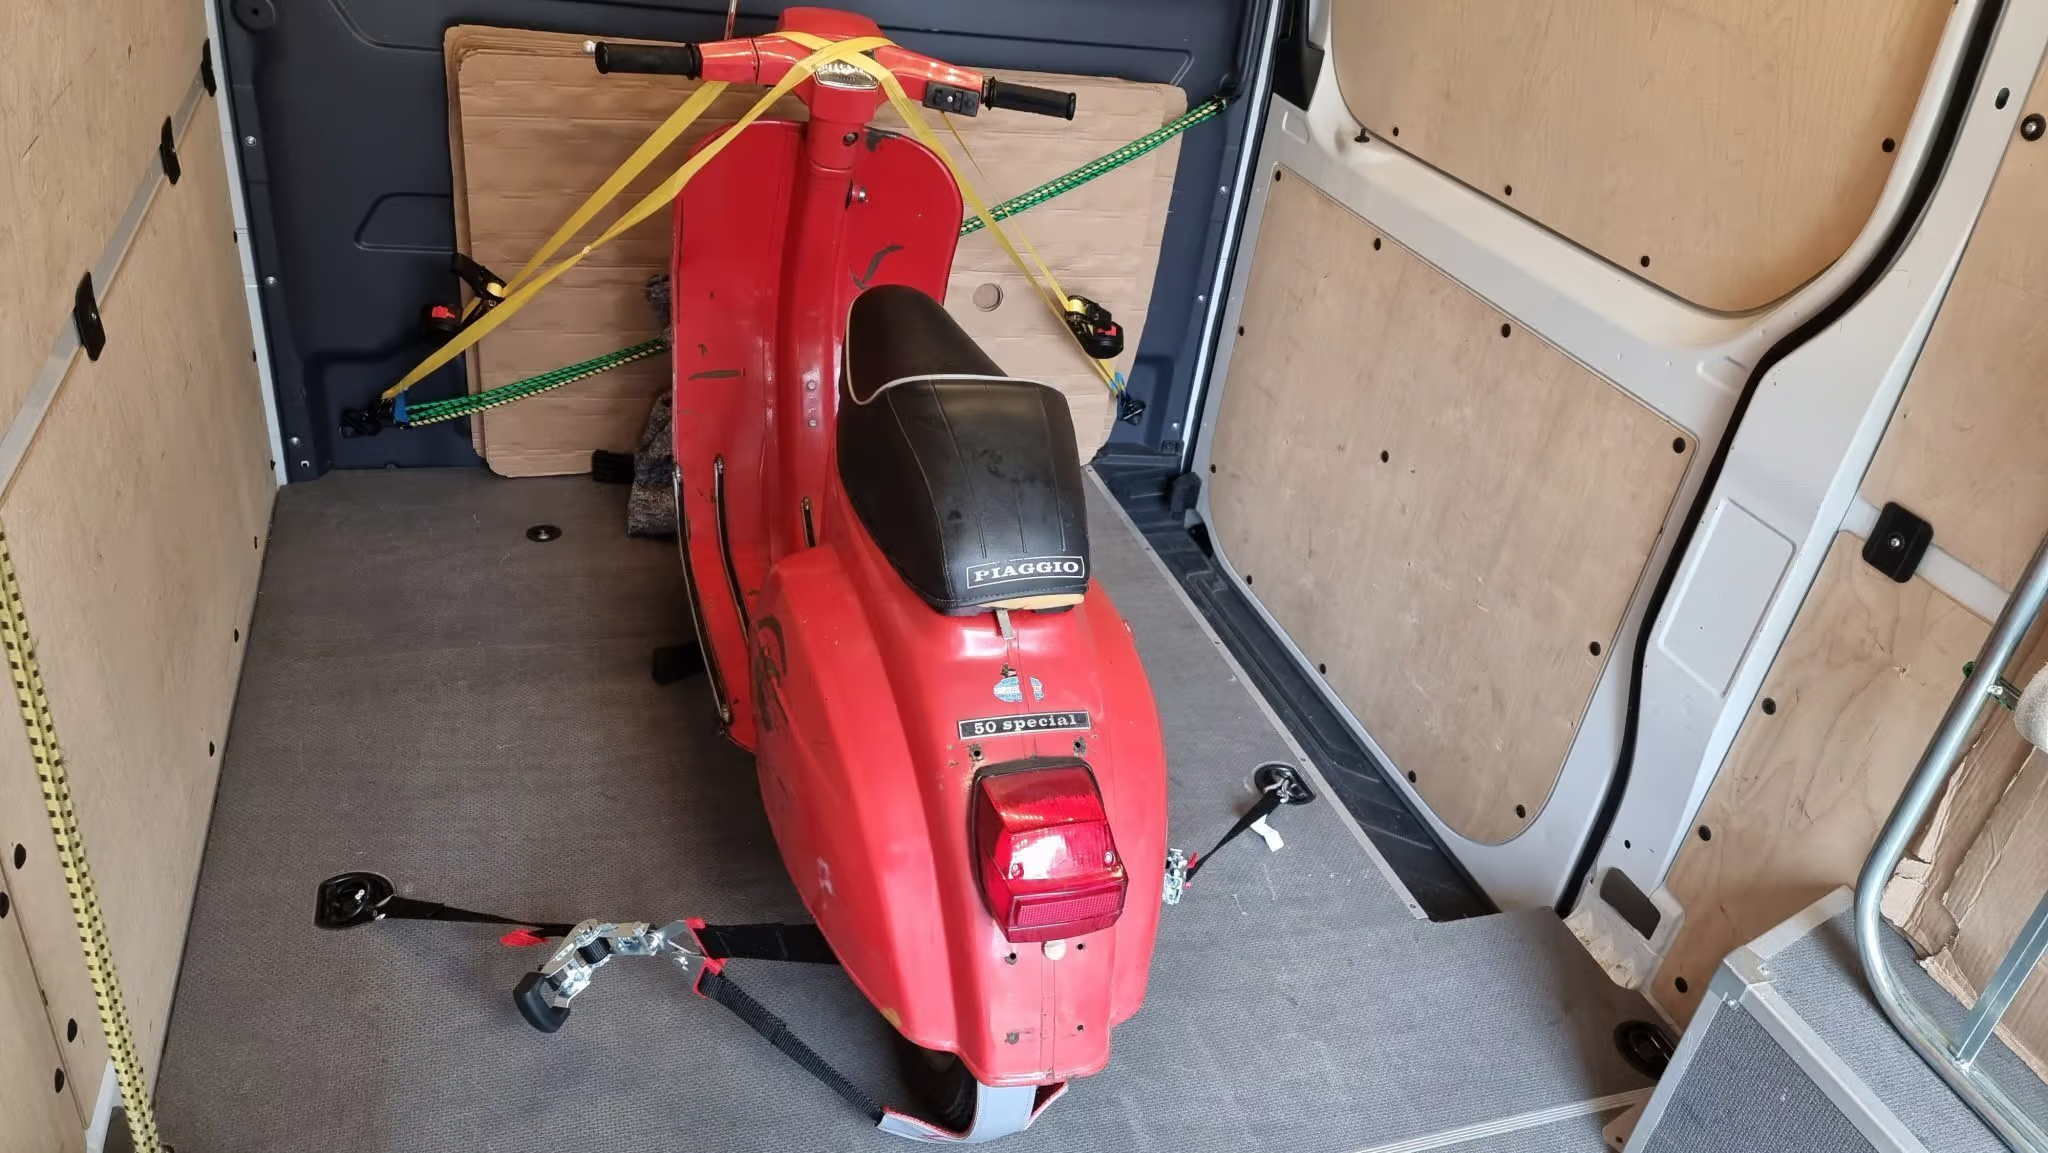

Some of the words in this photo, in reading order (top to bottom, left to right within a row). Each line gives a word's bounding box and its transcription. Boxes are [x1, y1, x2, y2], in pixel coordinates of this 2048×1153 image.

[974, 560, 1079, 582] PIAGGIO
[974, 721, 997, 734] 50
[1002, 714, 1077, 732] special
